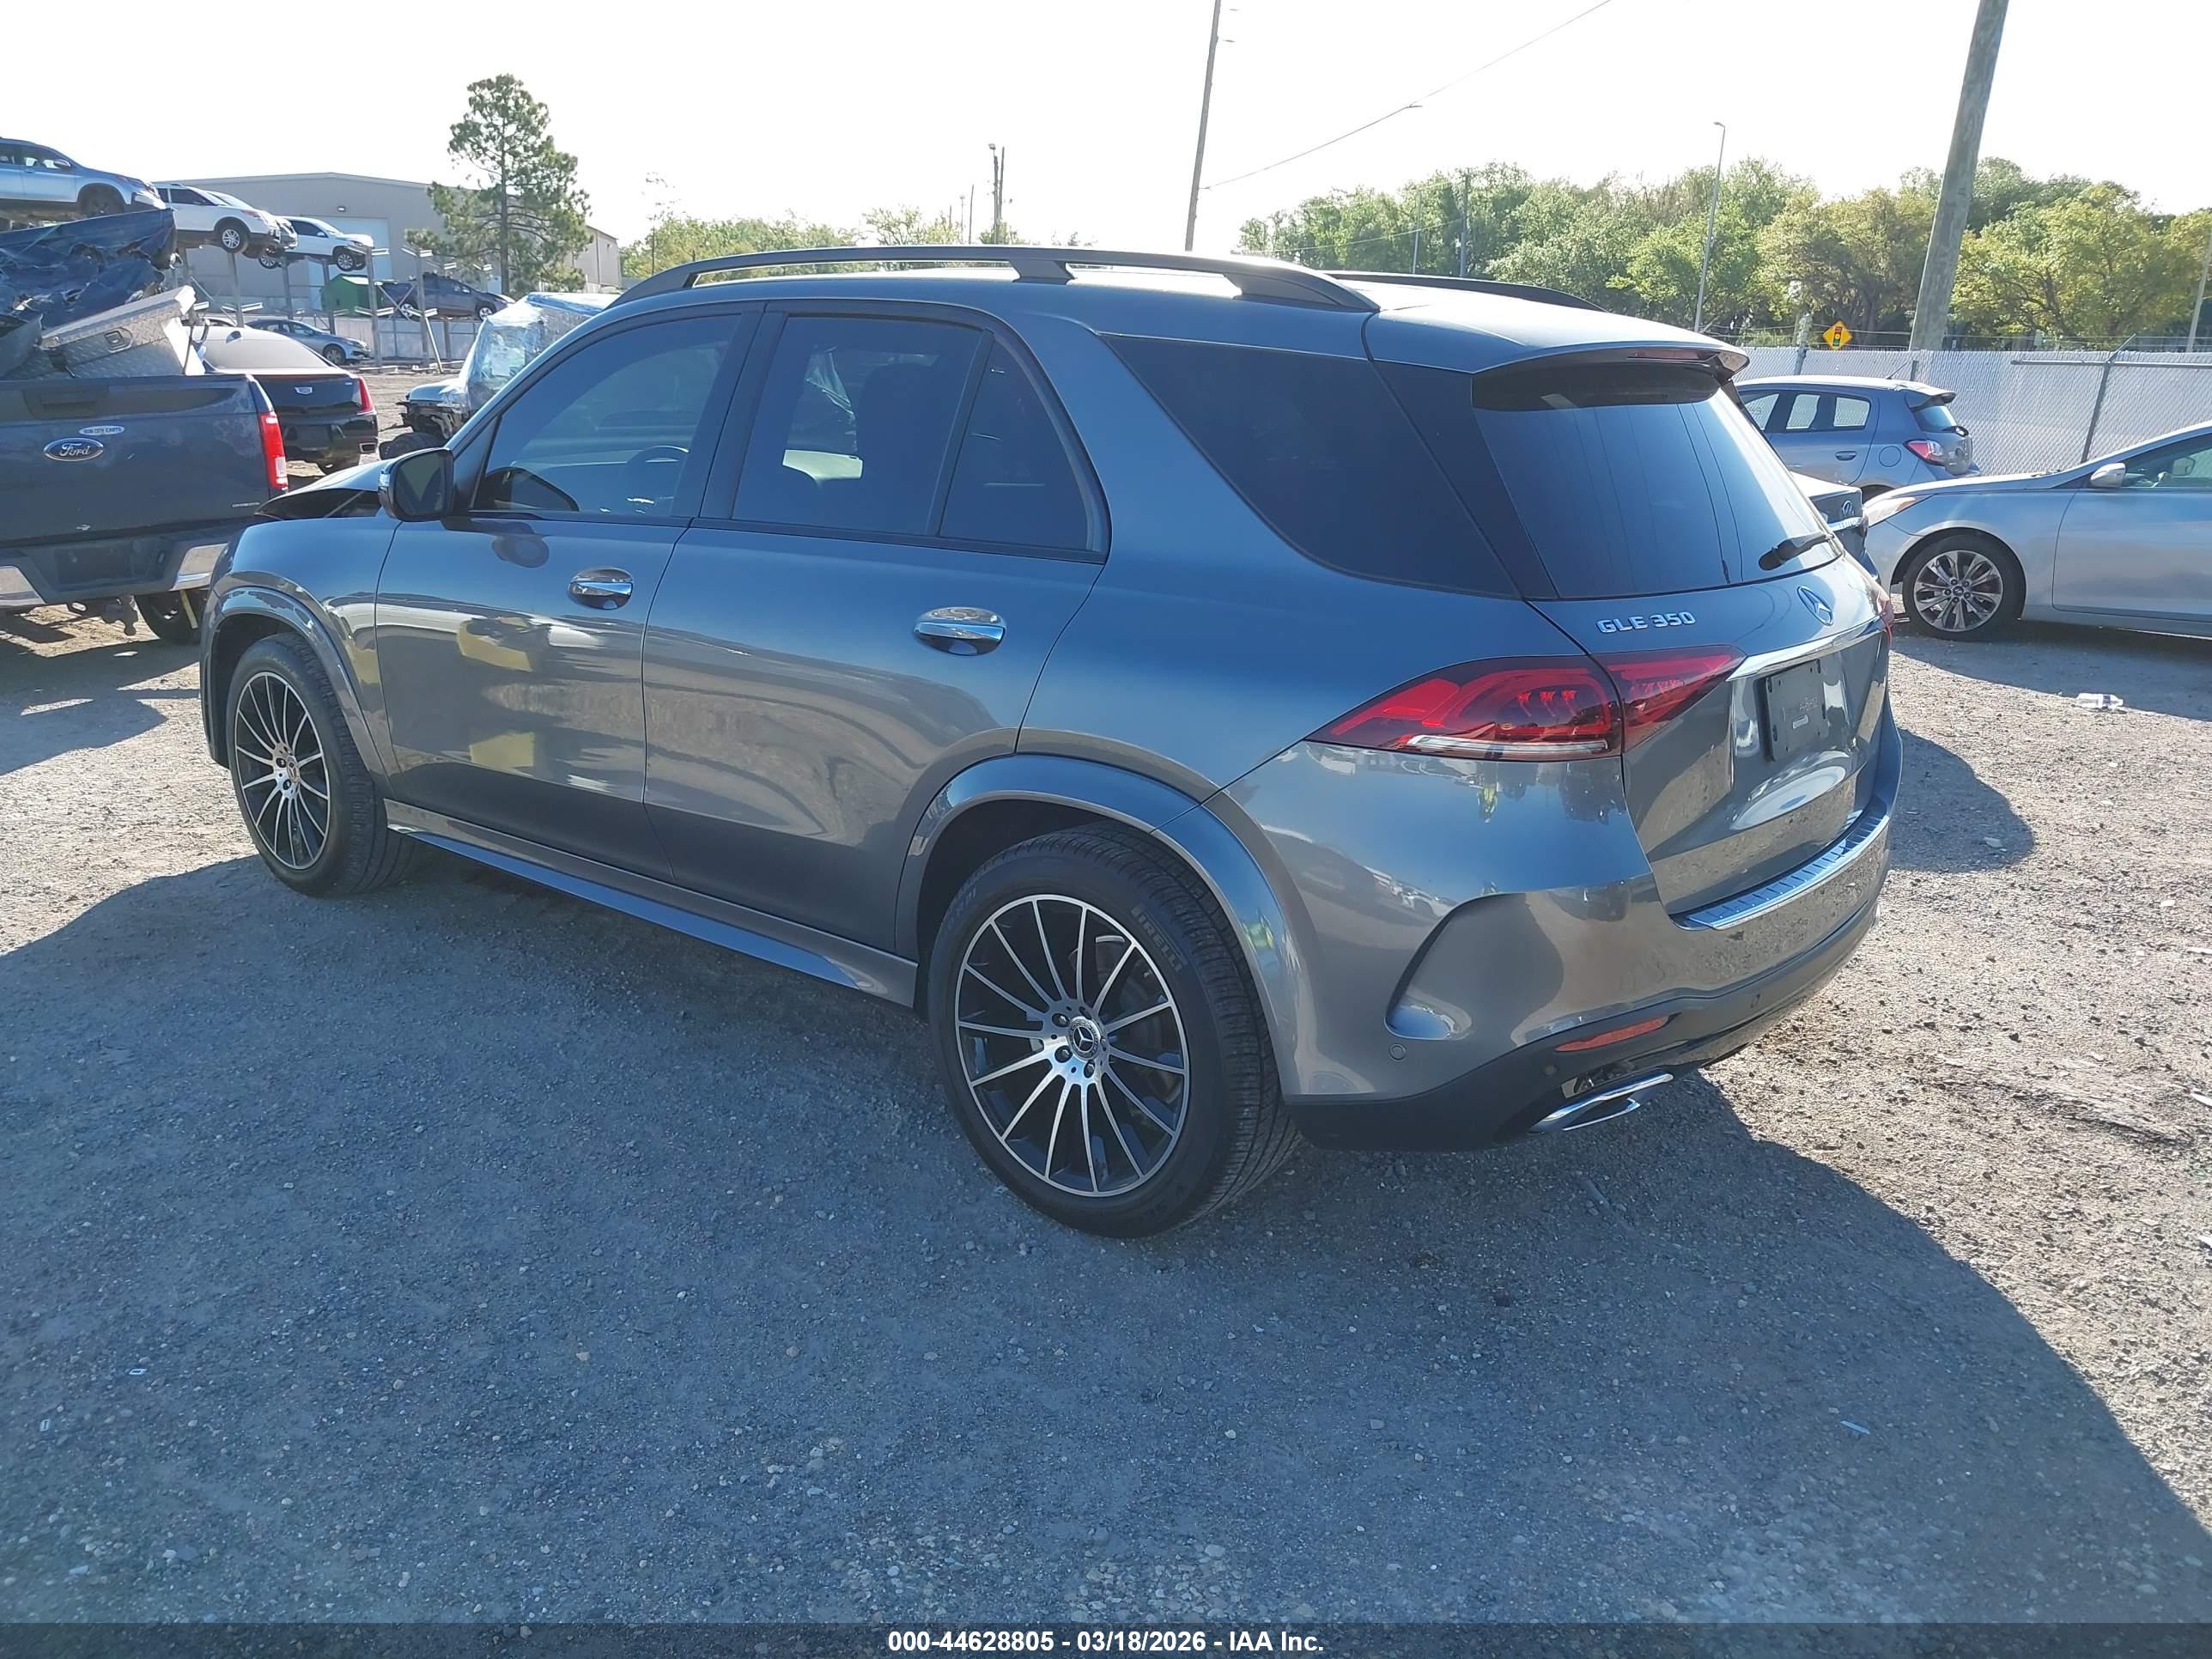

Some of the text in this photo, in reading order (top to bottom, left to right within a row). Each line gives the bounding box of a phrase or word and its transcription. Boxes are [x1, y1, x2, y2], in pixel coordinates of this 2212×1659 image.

[59, 442, 90, 457] Ford
[1596, 611, 1697, 633] GLE 350
